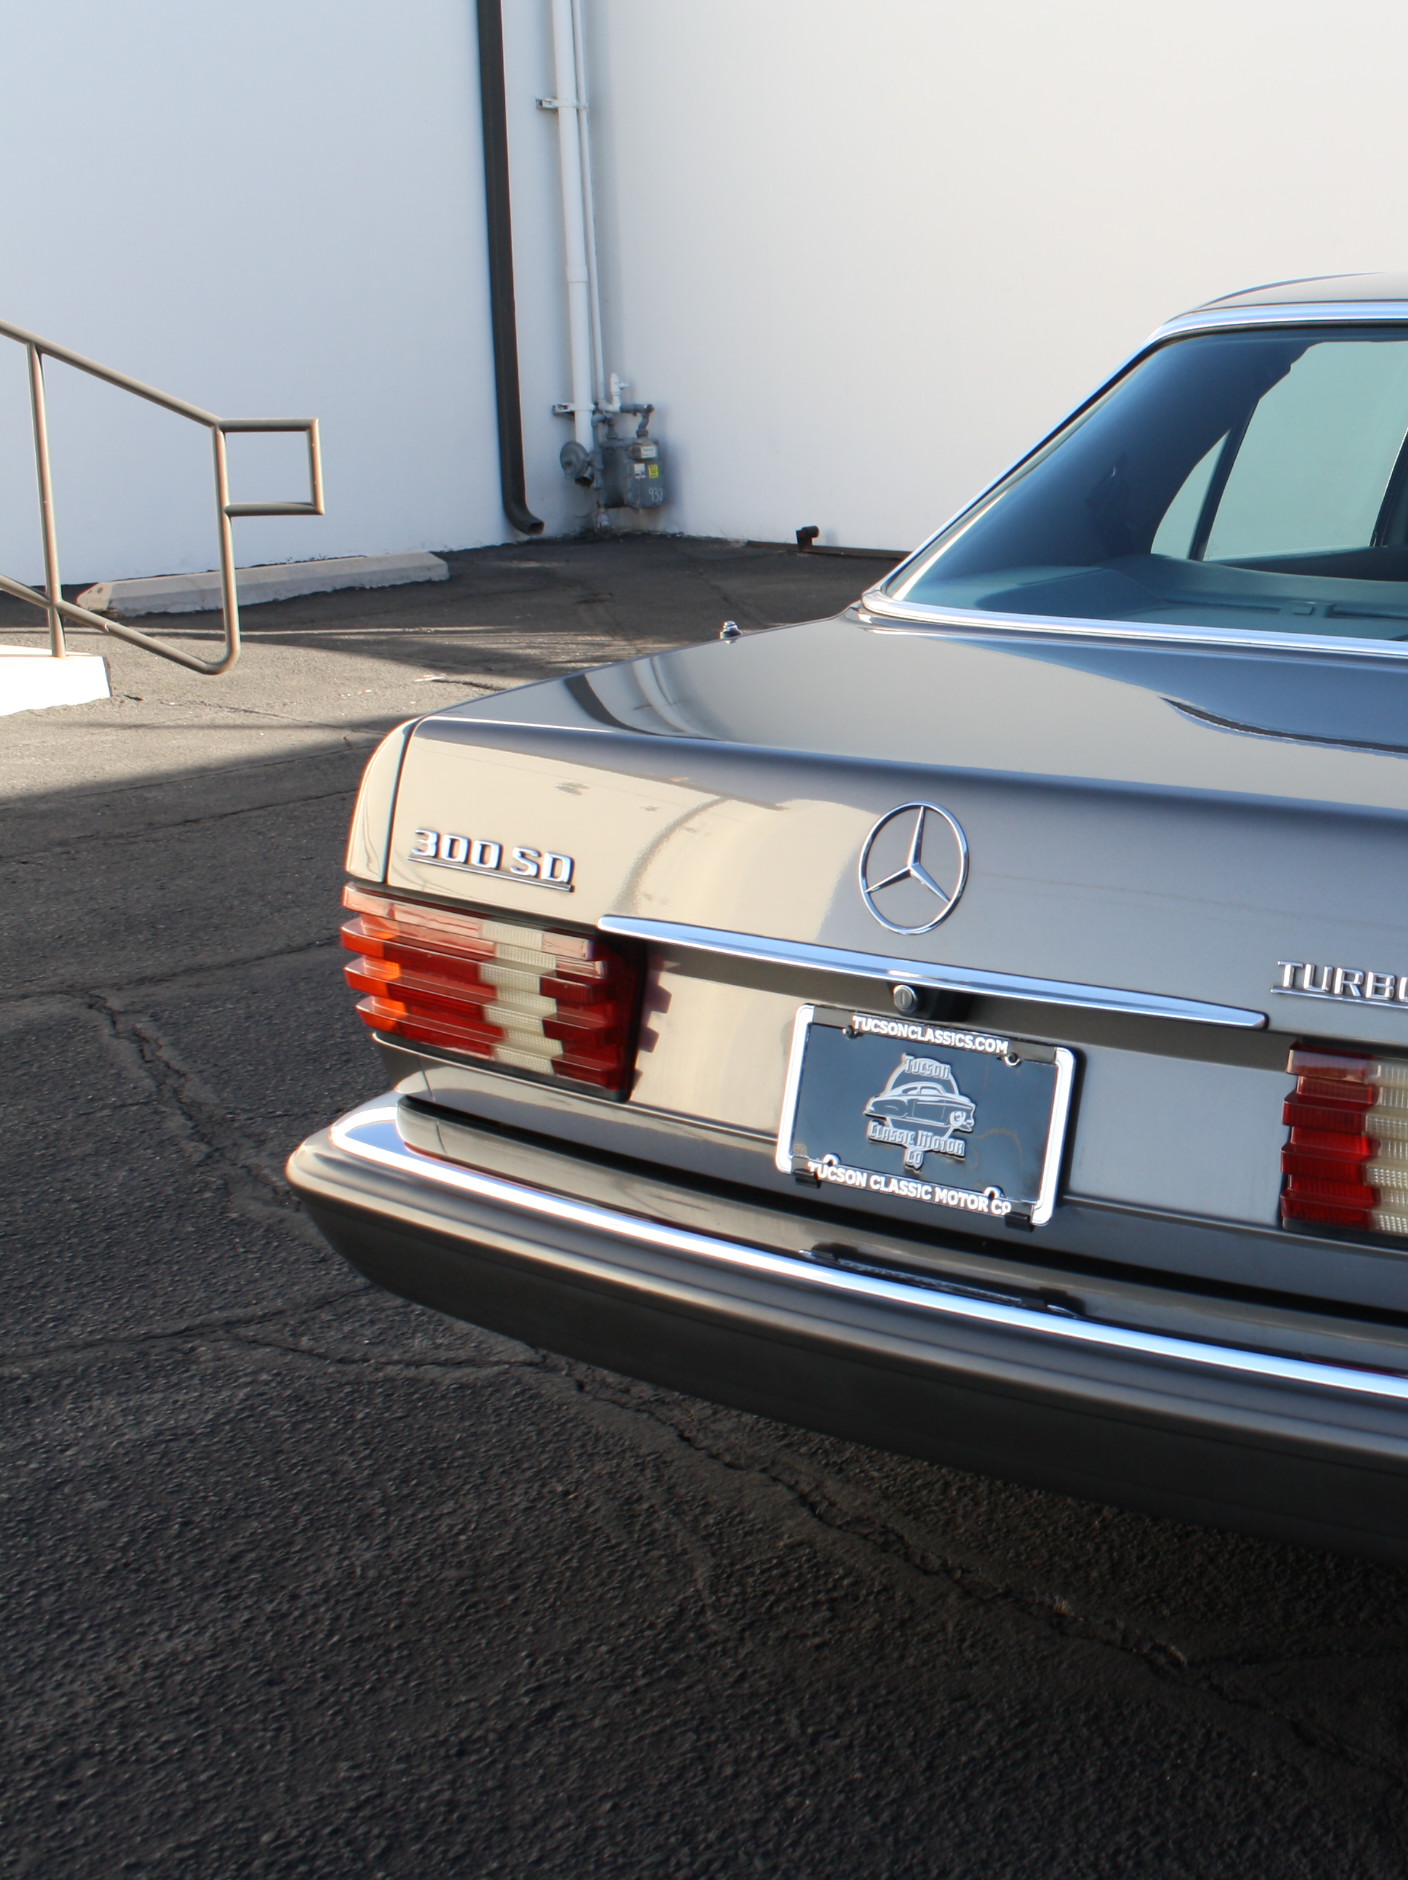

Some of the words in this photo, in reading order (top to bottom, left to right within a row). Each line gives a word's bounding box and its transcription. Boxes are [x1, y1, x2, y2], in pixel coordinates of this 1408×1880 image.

[411, 828, 504, 871] 300
[510, 846, 575, 884] SD
[852, 1015, 1009, 1054] TUCSONCLASSICS.COM
[807, 1160, 867, 1189] TUCSON
[869, 1175, 932, 1201] CLASSIC
[934, 1186, 989, 1213] MOTOR
[990, 1198, 1012, 1216] CO
